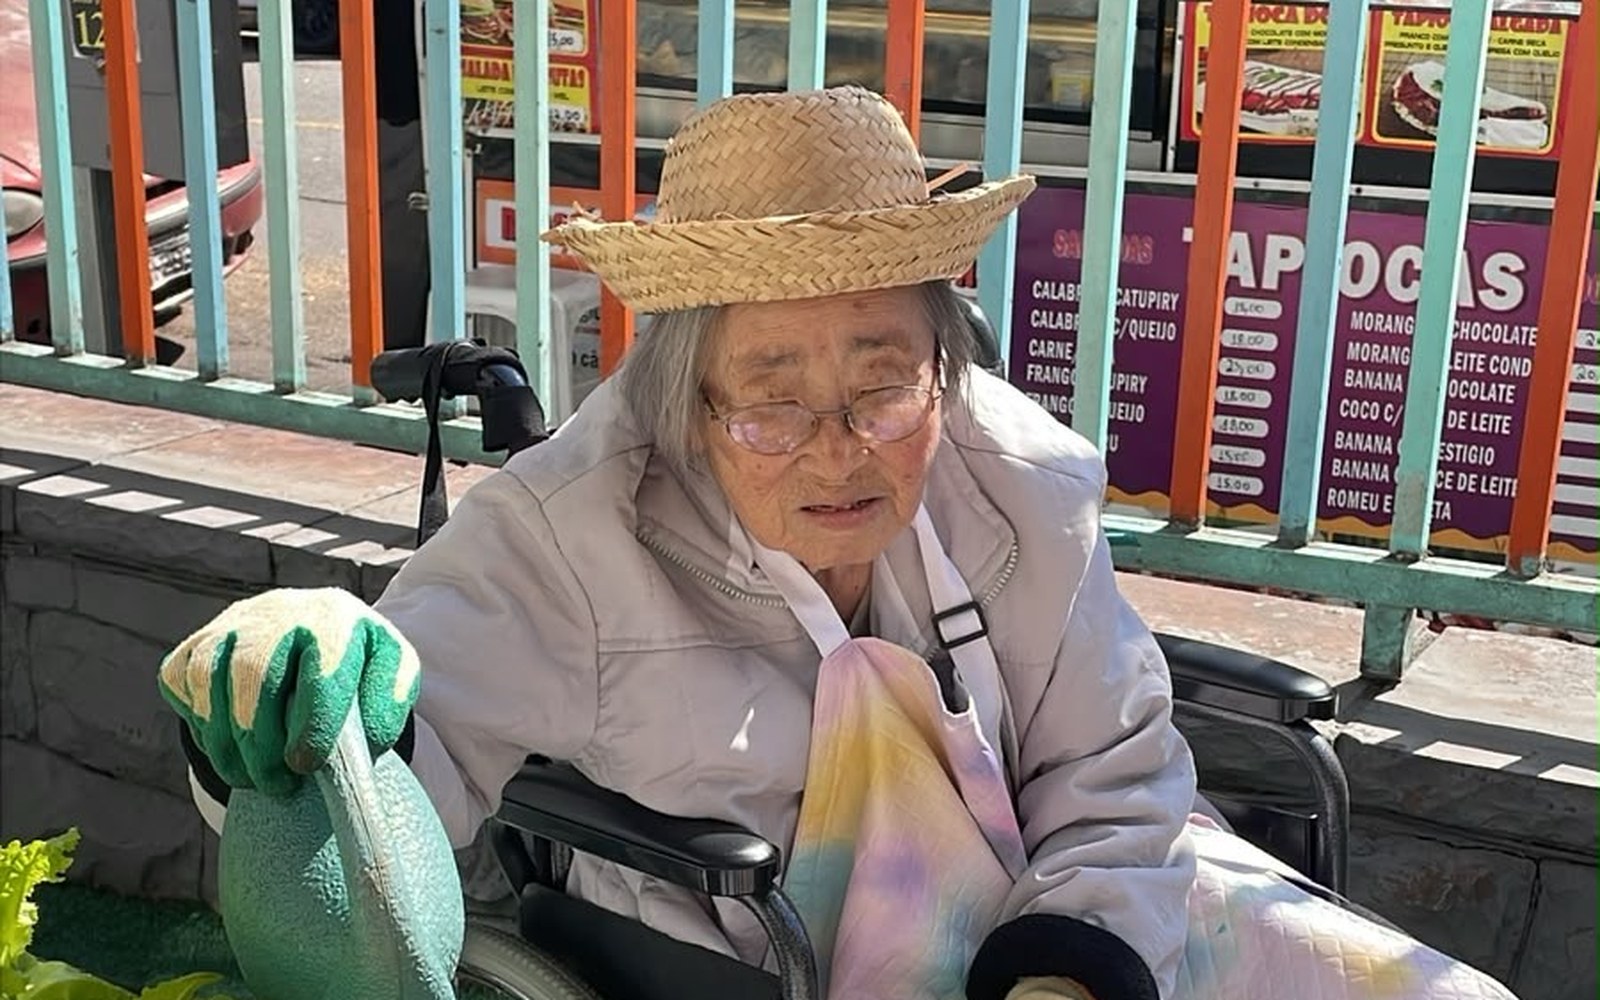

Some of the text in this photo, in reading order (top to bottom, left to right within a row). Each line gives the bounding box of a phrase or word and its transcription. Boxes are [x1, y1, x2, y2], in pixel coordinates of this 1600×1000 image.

[75, 11, 105, 48] 12
[1391, 10, 1450, 29] TAPIO
[1350, 311, 1538, 347] MORANG CHOCOLATE
[1026, 363, 1076, 386] FRANG
[1346, 342, 1532, 377] MORANG EITE COND
[1026, 392, 1075, 414] RANG
[1344, 369, 1515, 404] BANANA OCOLATE
[1340, 398, 1380, 422] COCO
[1447, 410, 1468, 430] DE
[1470, 412, 1512, 435] LEITE
[1334, 430, 1496, 466] BANANA ESTIGIO
[1331, 458, 1390, 483] BANANA
[1457, 473, 1478, 494] DE
[1327, 488, 1393, 513] ROMEU E
